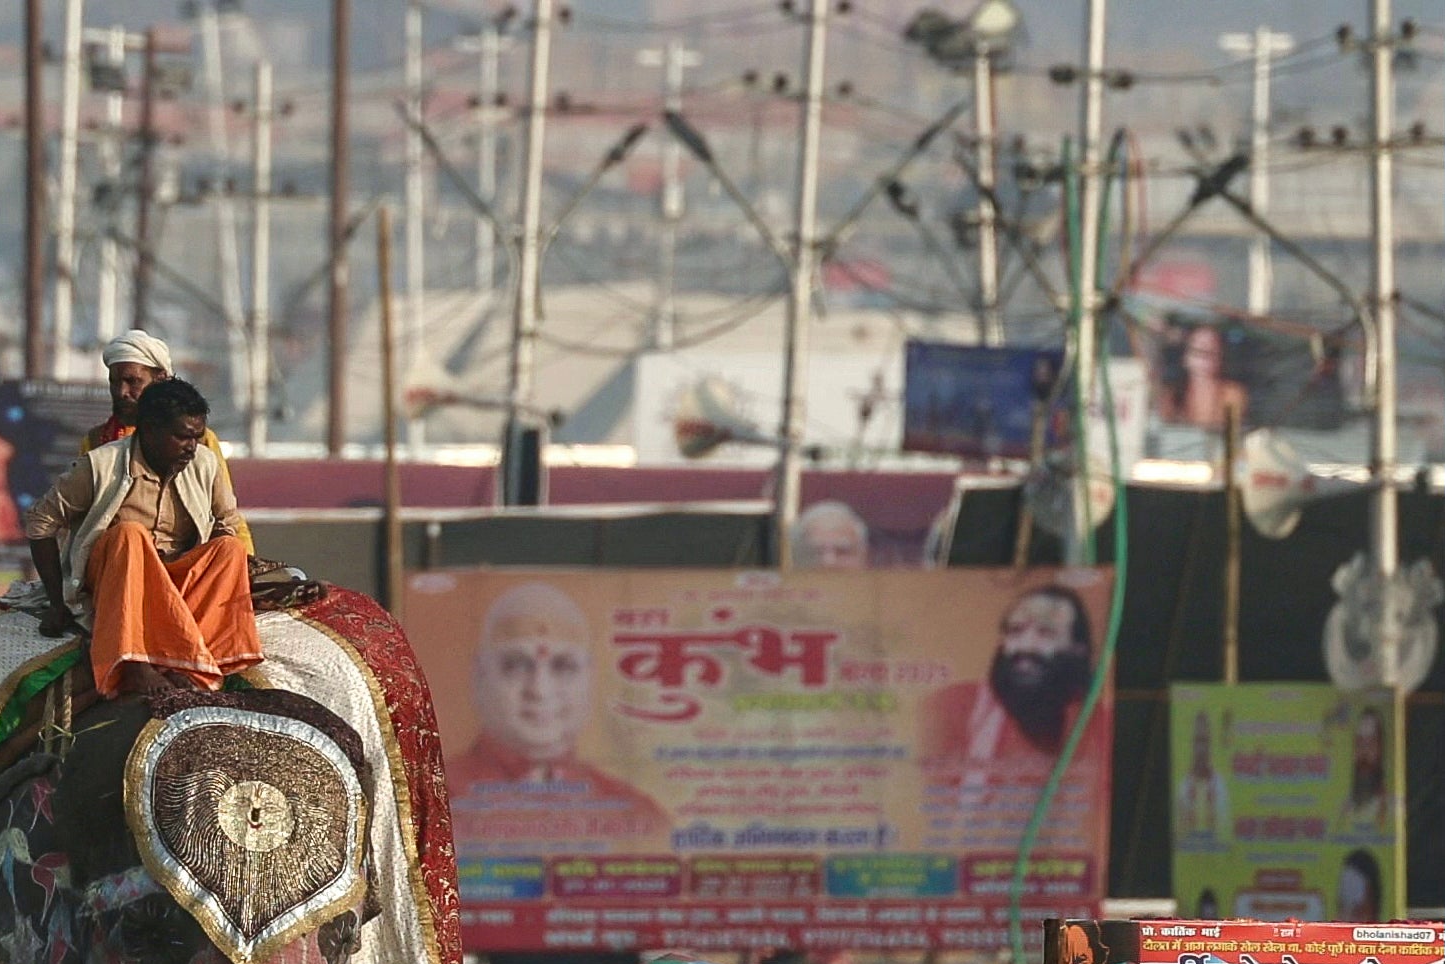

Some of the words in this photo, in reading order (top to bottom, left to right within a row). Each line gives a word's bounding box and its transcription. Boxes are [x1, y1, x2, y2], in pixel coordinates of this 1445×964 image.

[612, 606, 840, 724] कुंभ
[1160, 925, 1197, 938] कार्तिक
[1200, 924, 1222, 939] भाई
[1356, 930, 1432, 940] bholanishad07
[1142, 938, 1170, 951] दौलत
[1171, 937, 1183, 951] में
[1183, 941, 1205, 952] आग
[1304, 940, 1326, 955] कोई
[1344, 942, 1356, 954] तो
[1377, 942, 1397, 955] देना
[1398, 942, 1433, 956] कार्तिक
